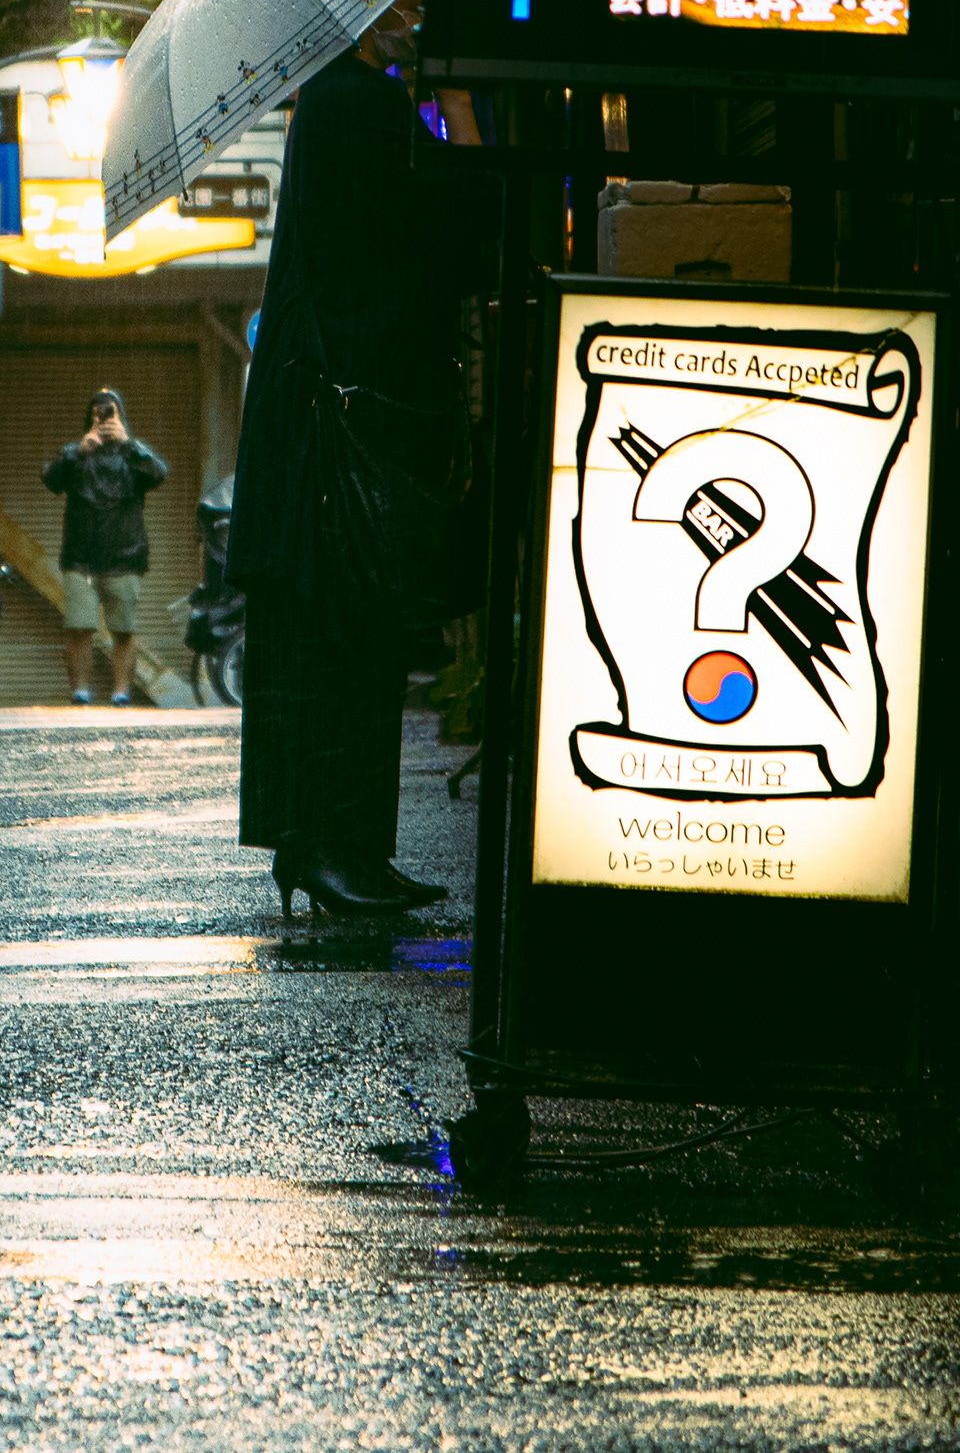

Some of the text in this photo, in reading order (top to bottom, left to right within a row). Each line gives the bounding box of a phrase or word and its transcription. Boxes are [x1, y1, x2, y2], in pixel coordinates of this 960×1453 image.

[596, 342, 860, 392] credit cards Accpeted
[690, 500, 735, 548] BAR
[620, 752, 788, 787] 어서오세요
[618, 810, 786, 846] welcome
[607, 850, 797, 881] いらっしゃいませ
